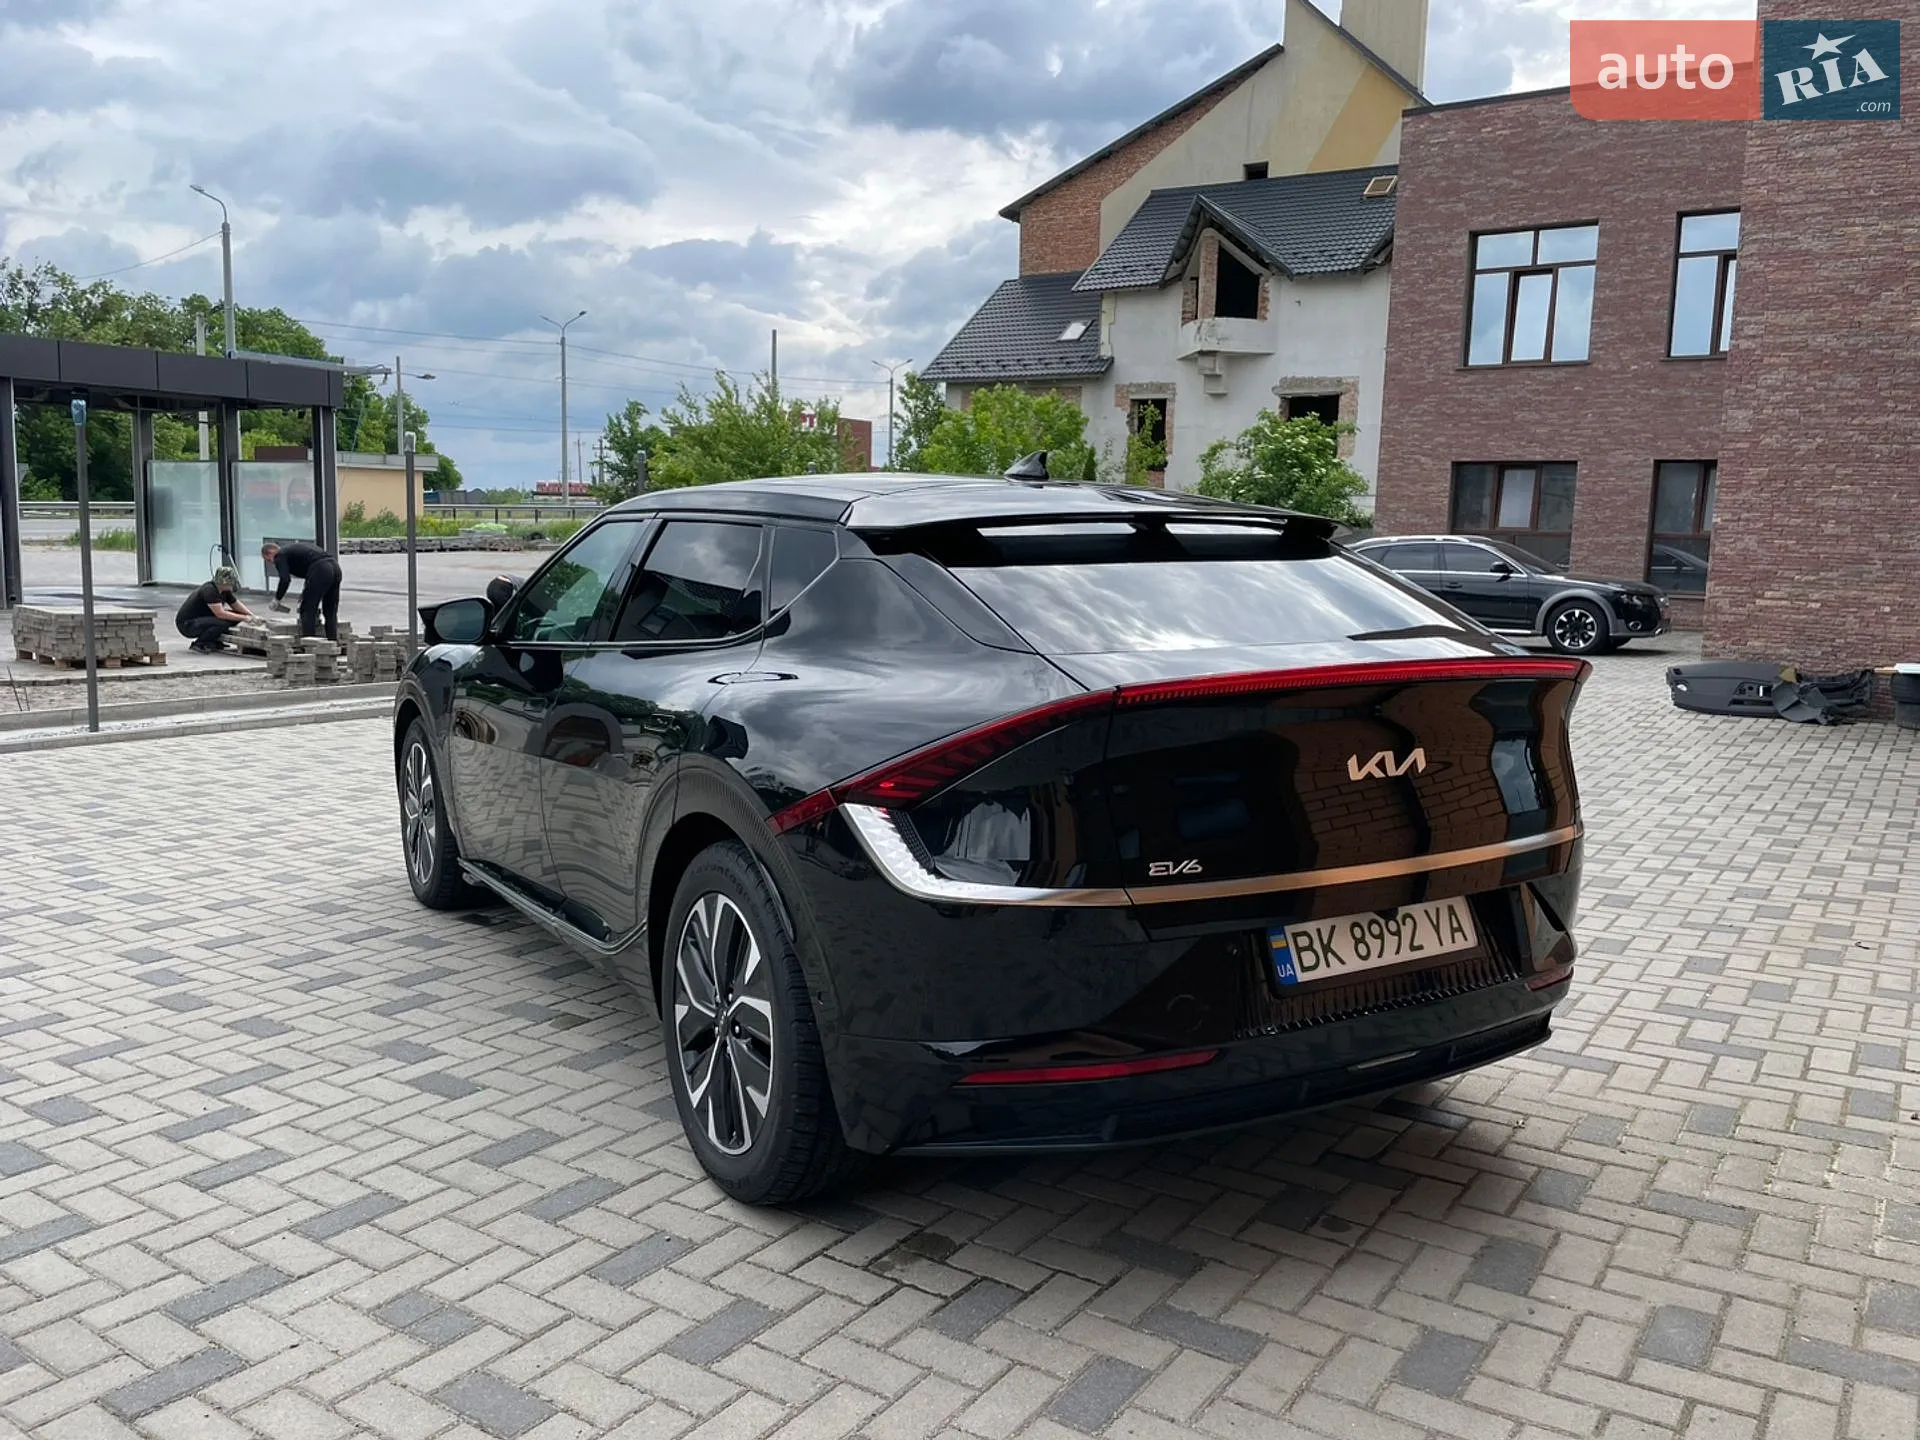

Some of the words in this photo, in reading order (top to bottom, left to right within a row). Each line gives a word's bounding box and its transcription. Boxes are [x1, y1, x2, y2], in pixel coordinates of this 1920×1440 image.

[1347, 748, 1427, 781] KIA
[1148, 859, 1203, 876] EV6
[1291, 924, 1346, 973] BK
[1349, 913, 1424, 961] 8992
[1424, 904, 1468, 947] YA
[1276, 964, 1294, 978] UA
